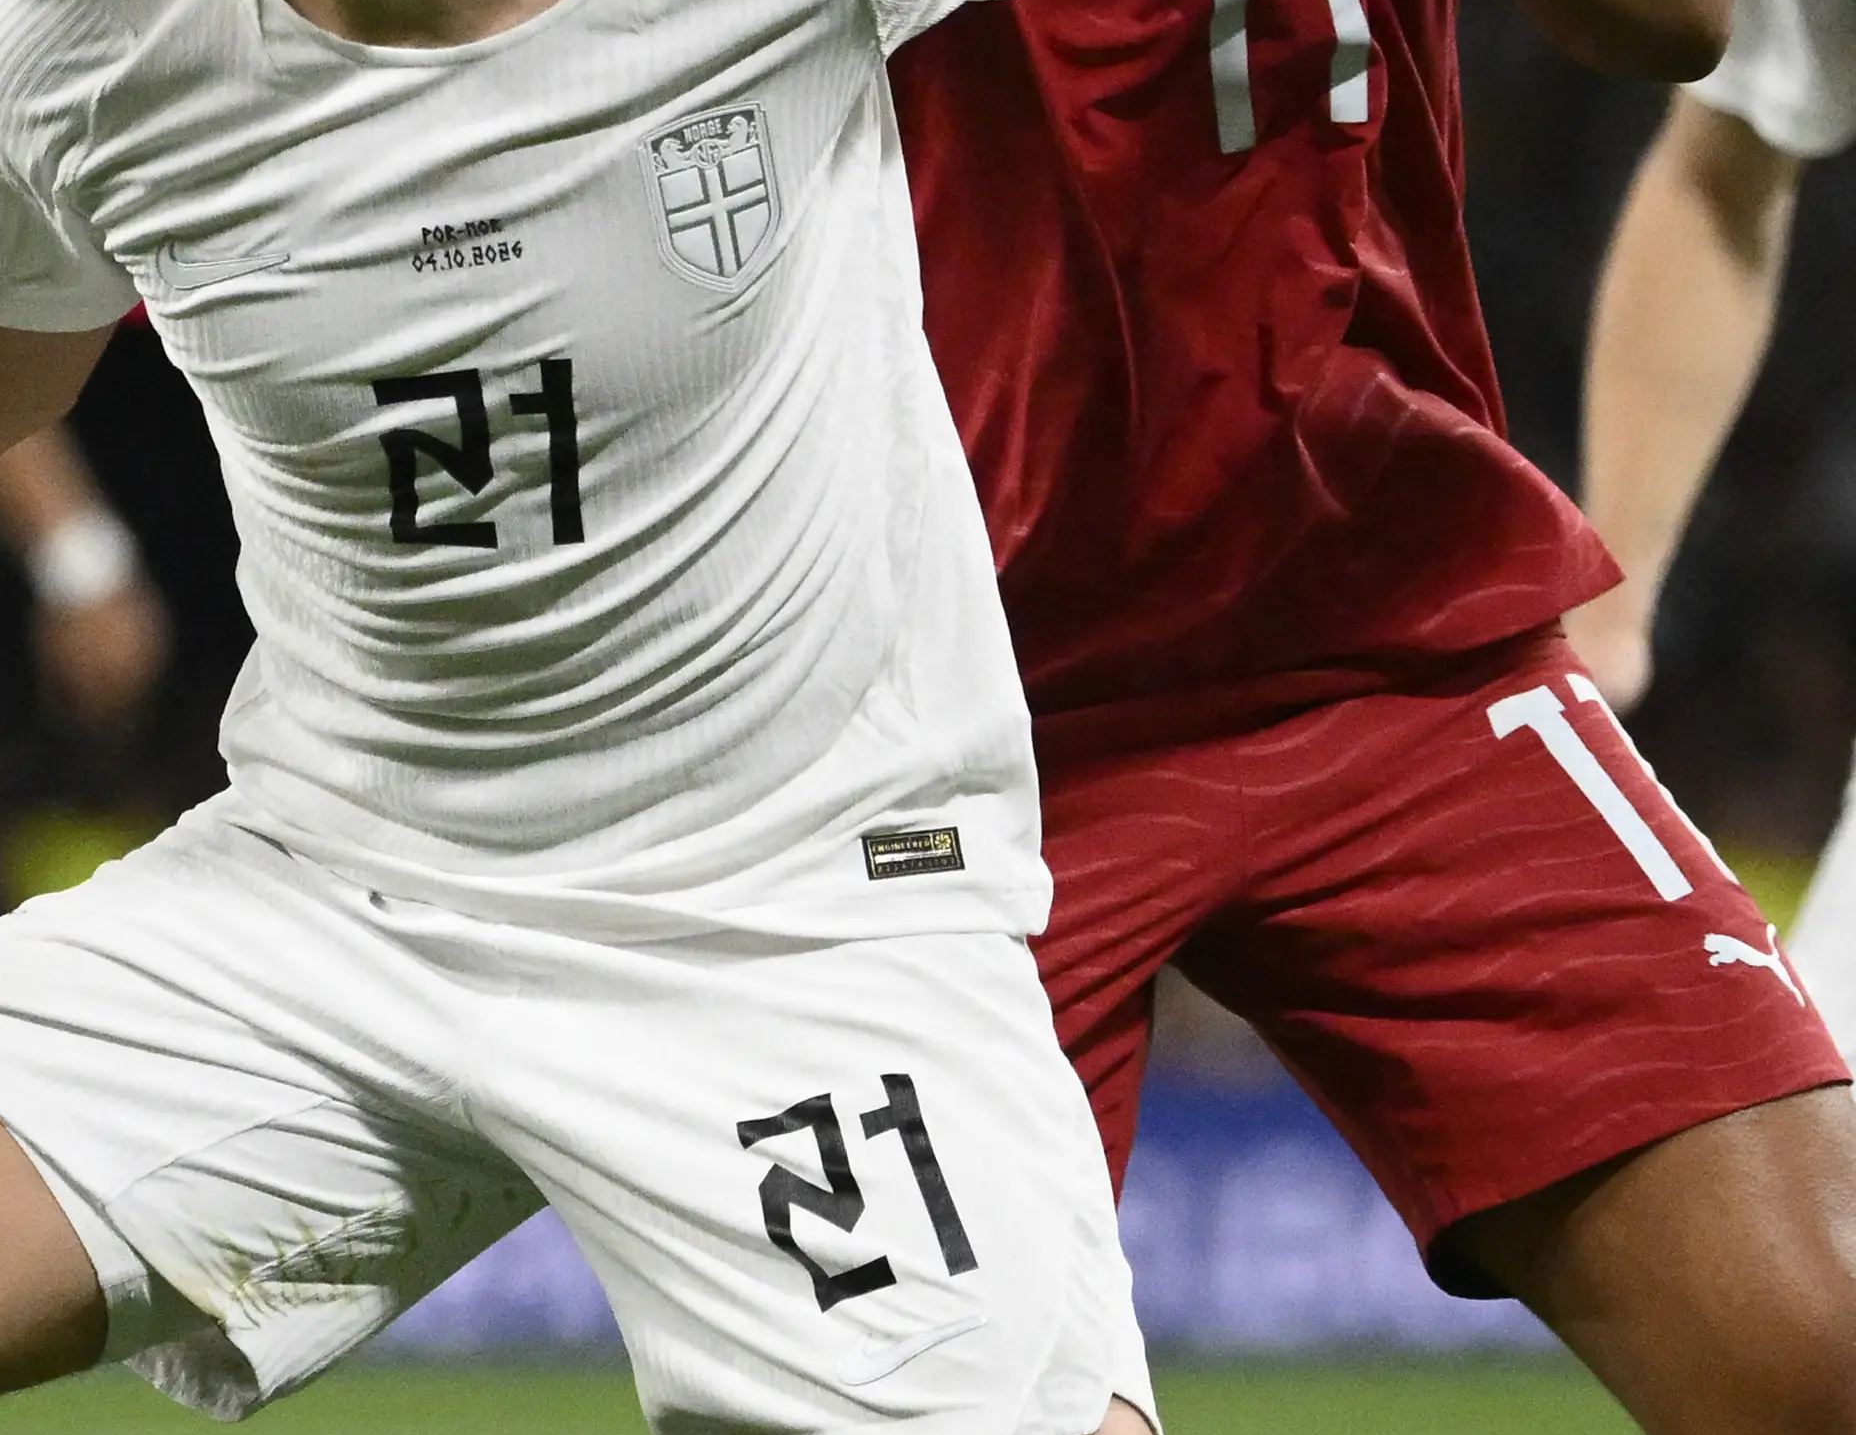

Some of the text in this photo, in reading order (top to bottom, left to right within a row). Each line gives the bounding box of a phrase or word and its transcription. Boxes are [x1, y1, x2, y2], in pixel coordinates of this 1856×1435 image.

[683, 117, 723, 145] NORGE
[422, 218, 504, 246] POR-NOR
[411, 239, 524, 274] 04.10.2026
[372, 358, 586, 550] 21
[736, 1073, 980, 1314] 21
